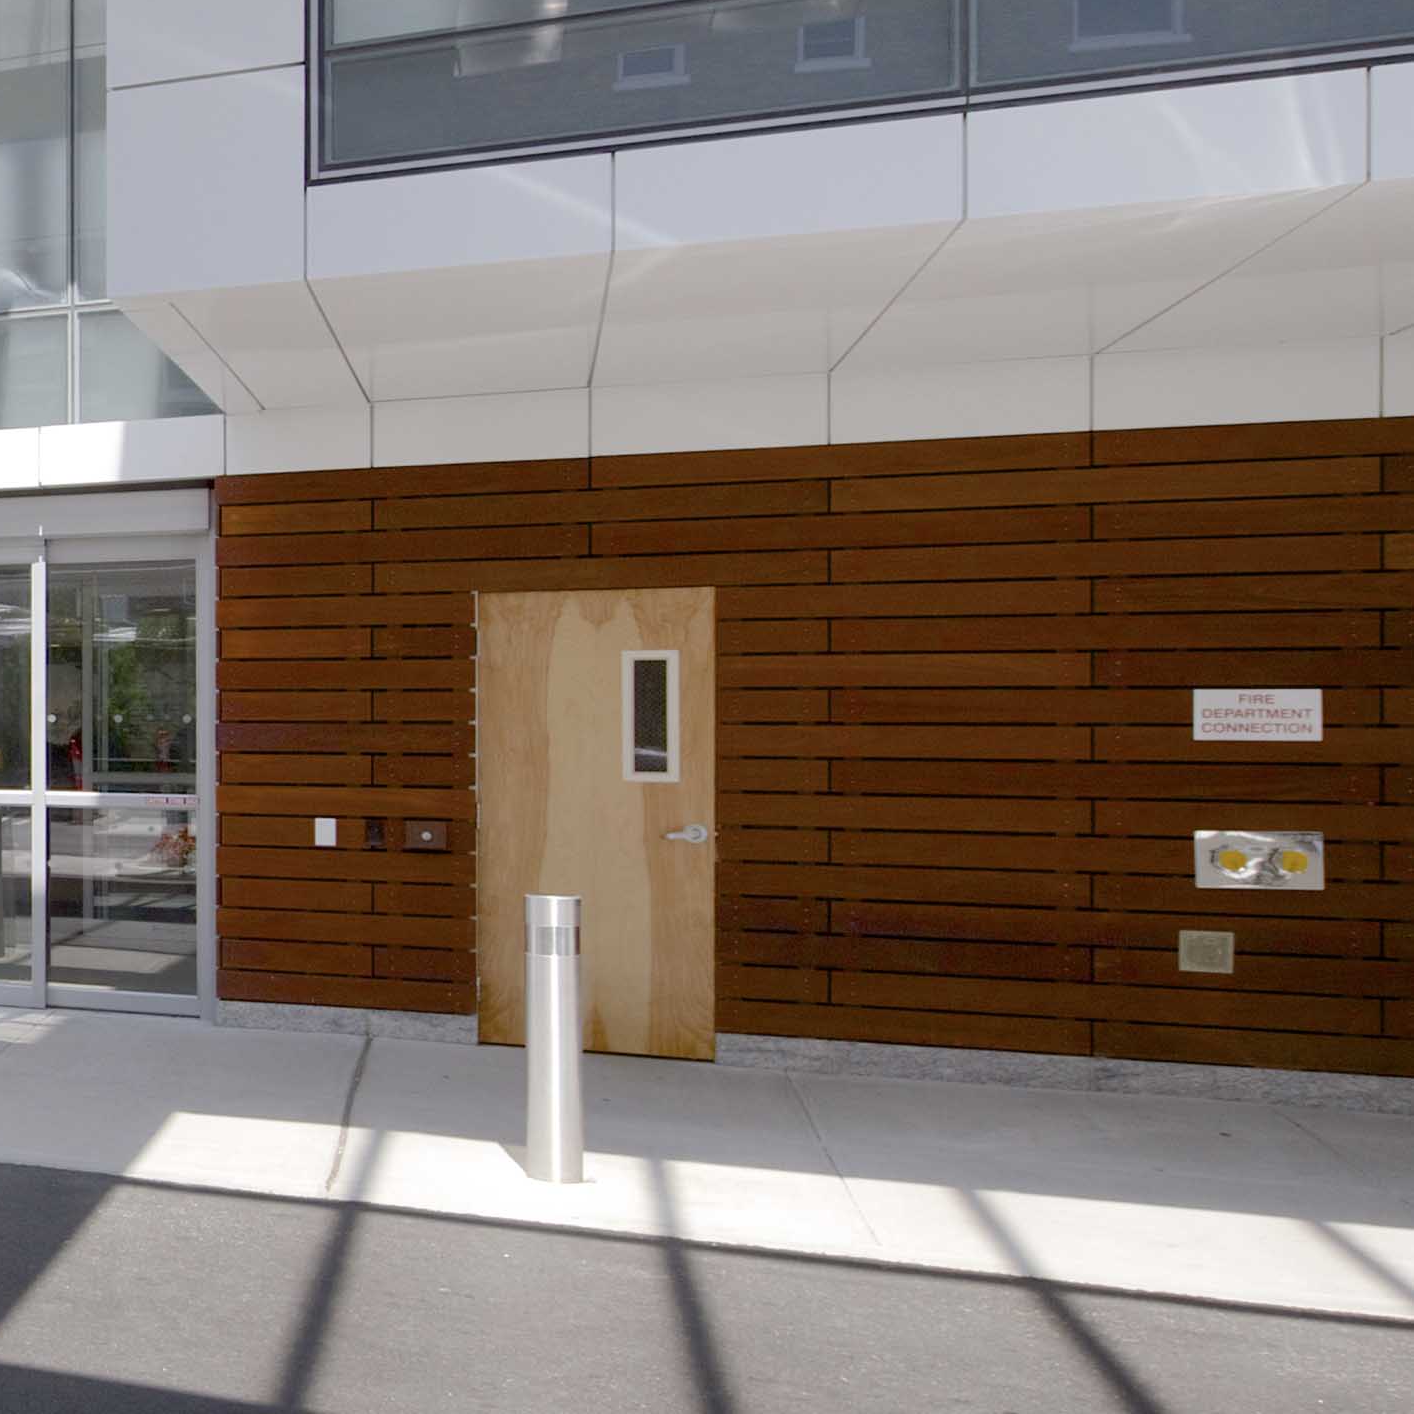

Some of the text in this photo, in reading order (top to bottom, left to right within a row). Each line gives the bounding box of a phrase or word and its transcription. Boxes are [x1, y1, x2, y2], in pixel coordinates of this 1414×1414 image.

[1238, 693, 1275, 704] FIRE
[1202, 708, 1313, 719] DEPARTMENT
[1201, 722, 1313, 733] CONNECTION
